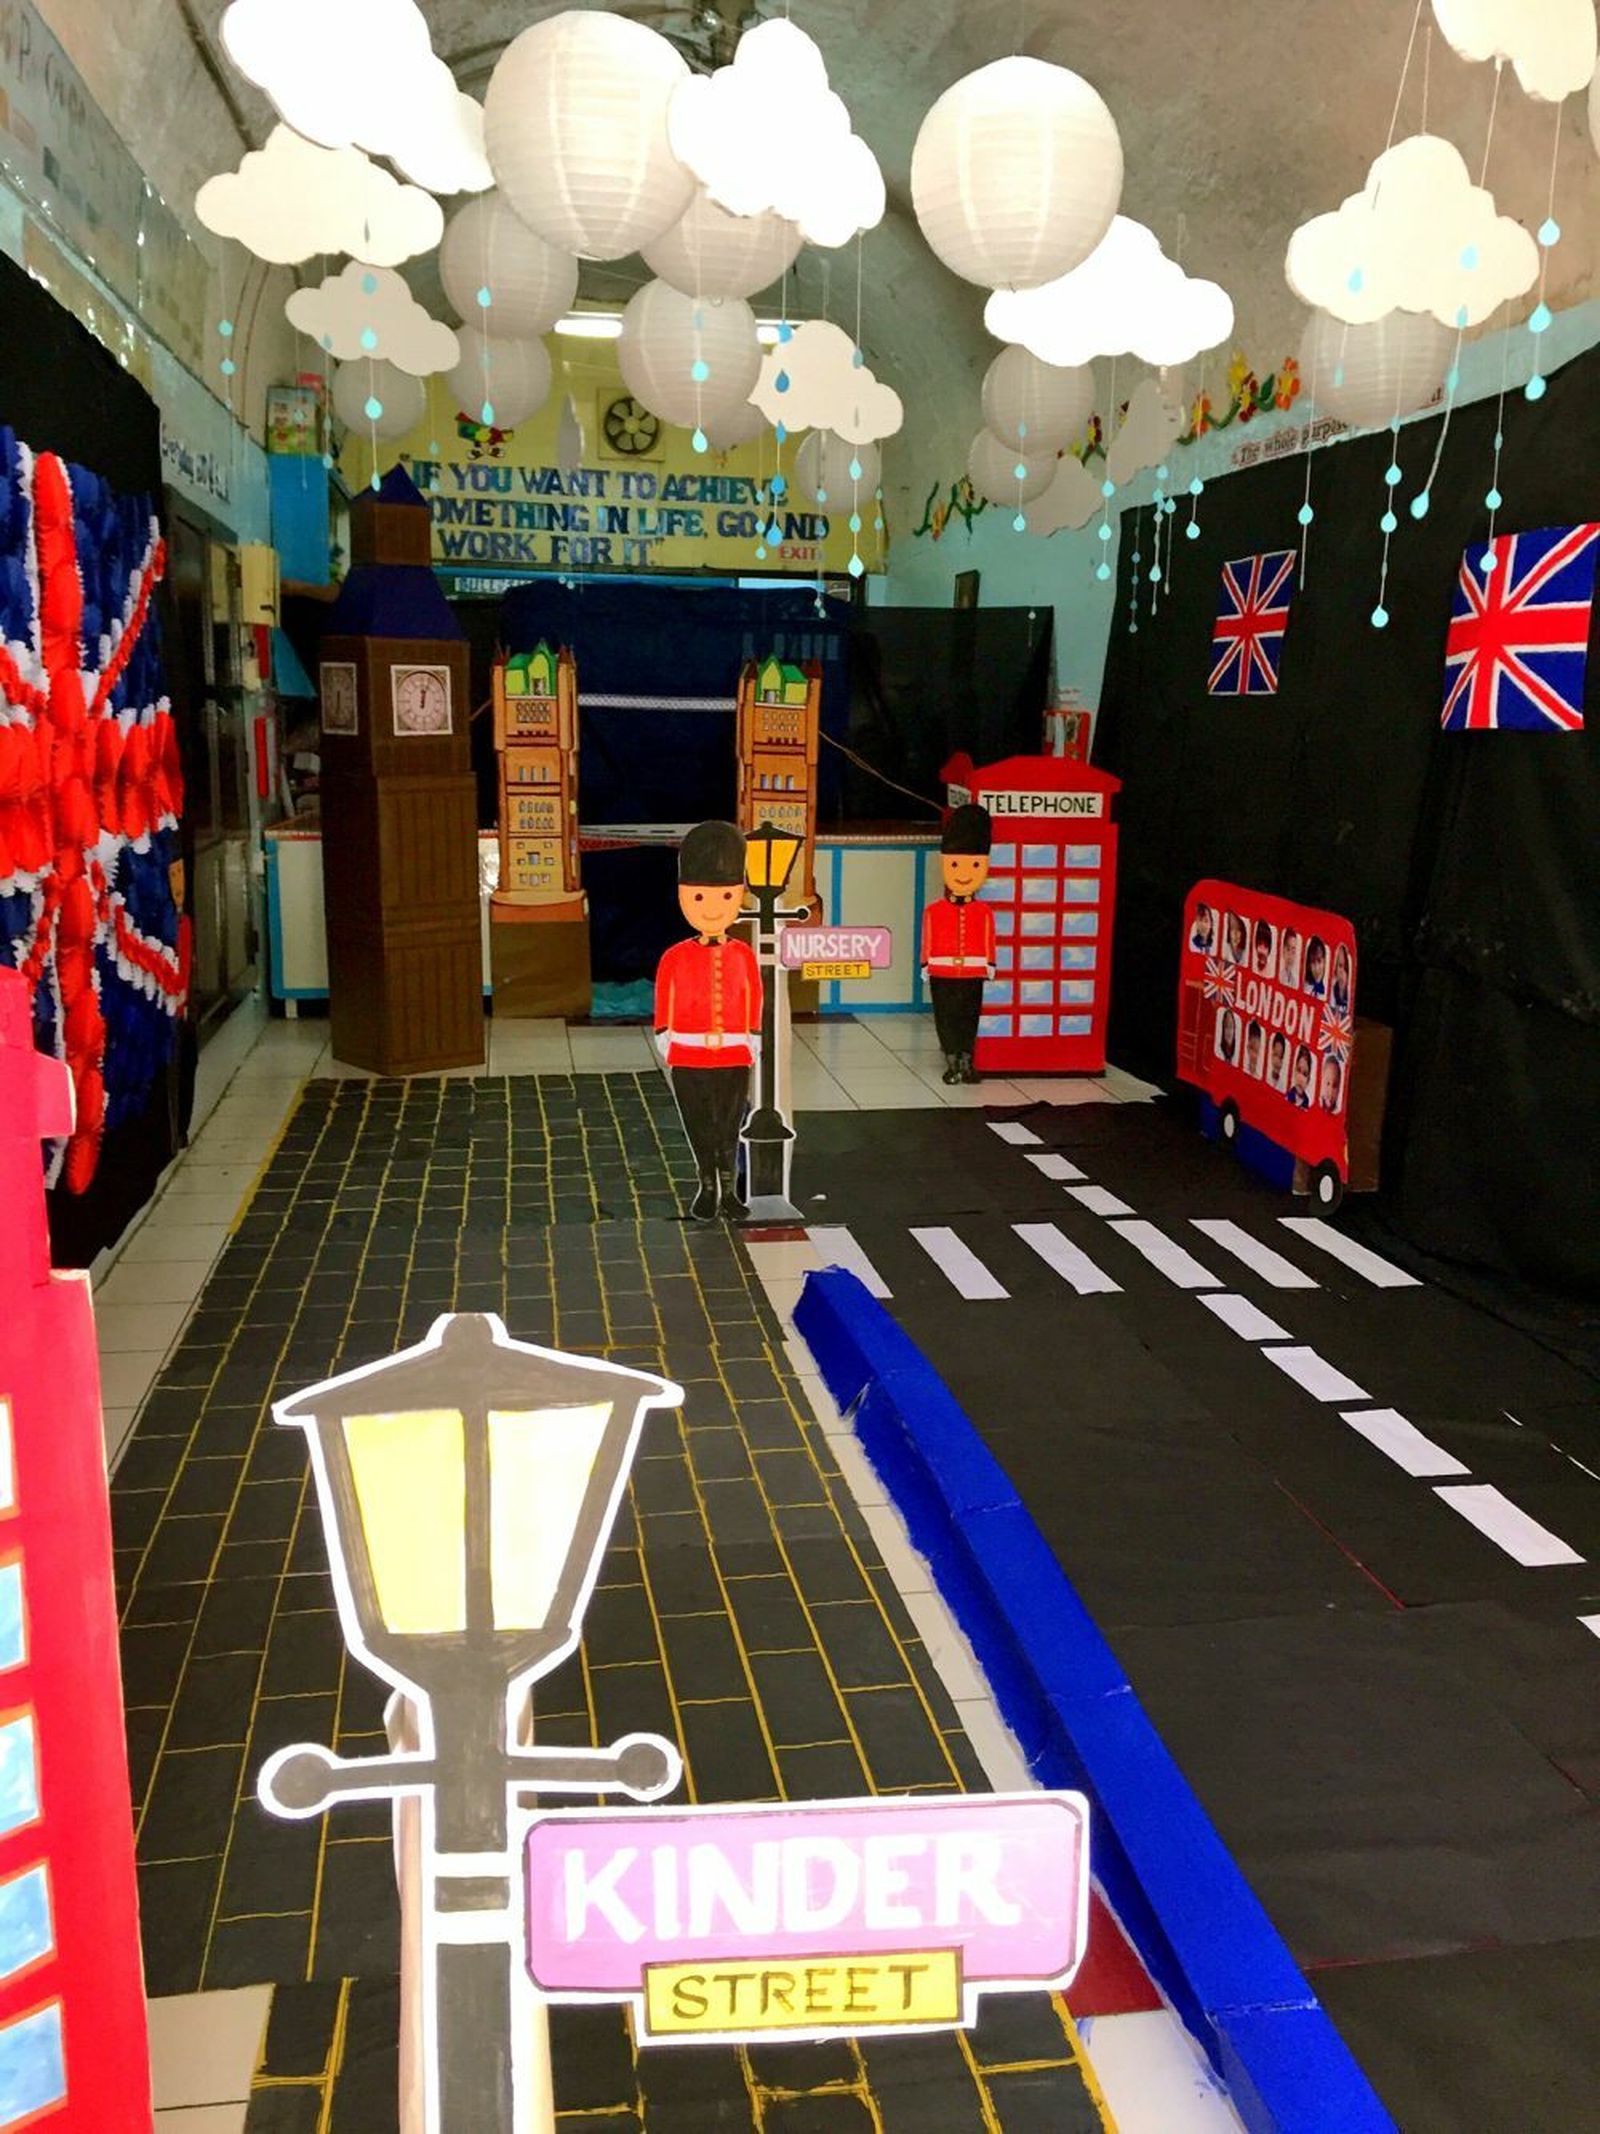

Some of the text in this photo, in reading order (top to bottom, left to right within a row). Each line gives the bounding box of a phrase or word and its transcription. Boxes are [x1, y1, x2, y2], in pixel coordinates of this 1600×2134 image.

[448, 462, 512, 493] YOU
[518, 466, 610, 498] WANT
[616, 471, 657, 500] TO
[660, 473, 788, 507] ACHIEVE
[429, 495, 590, 532] OMETHING
[596, 505, 630, 534] IN
[717, 511, 758, 539] GO
[762, 511, 829, 540] AND
[437, 529, 537, 562] WORK
[550, 535, 613, 565] FOR
[982, 794, 1096, 814] TELEPHONE
[786, 933, 883, 959] NURSERY
[806, 963, 864, 977] STREET
[1235, 970, 1315, 1044] LONDON
[563, 1831, 1022, 1945] KINDER
[672, 1963, 931, 2020] STREET
